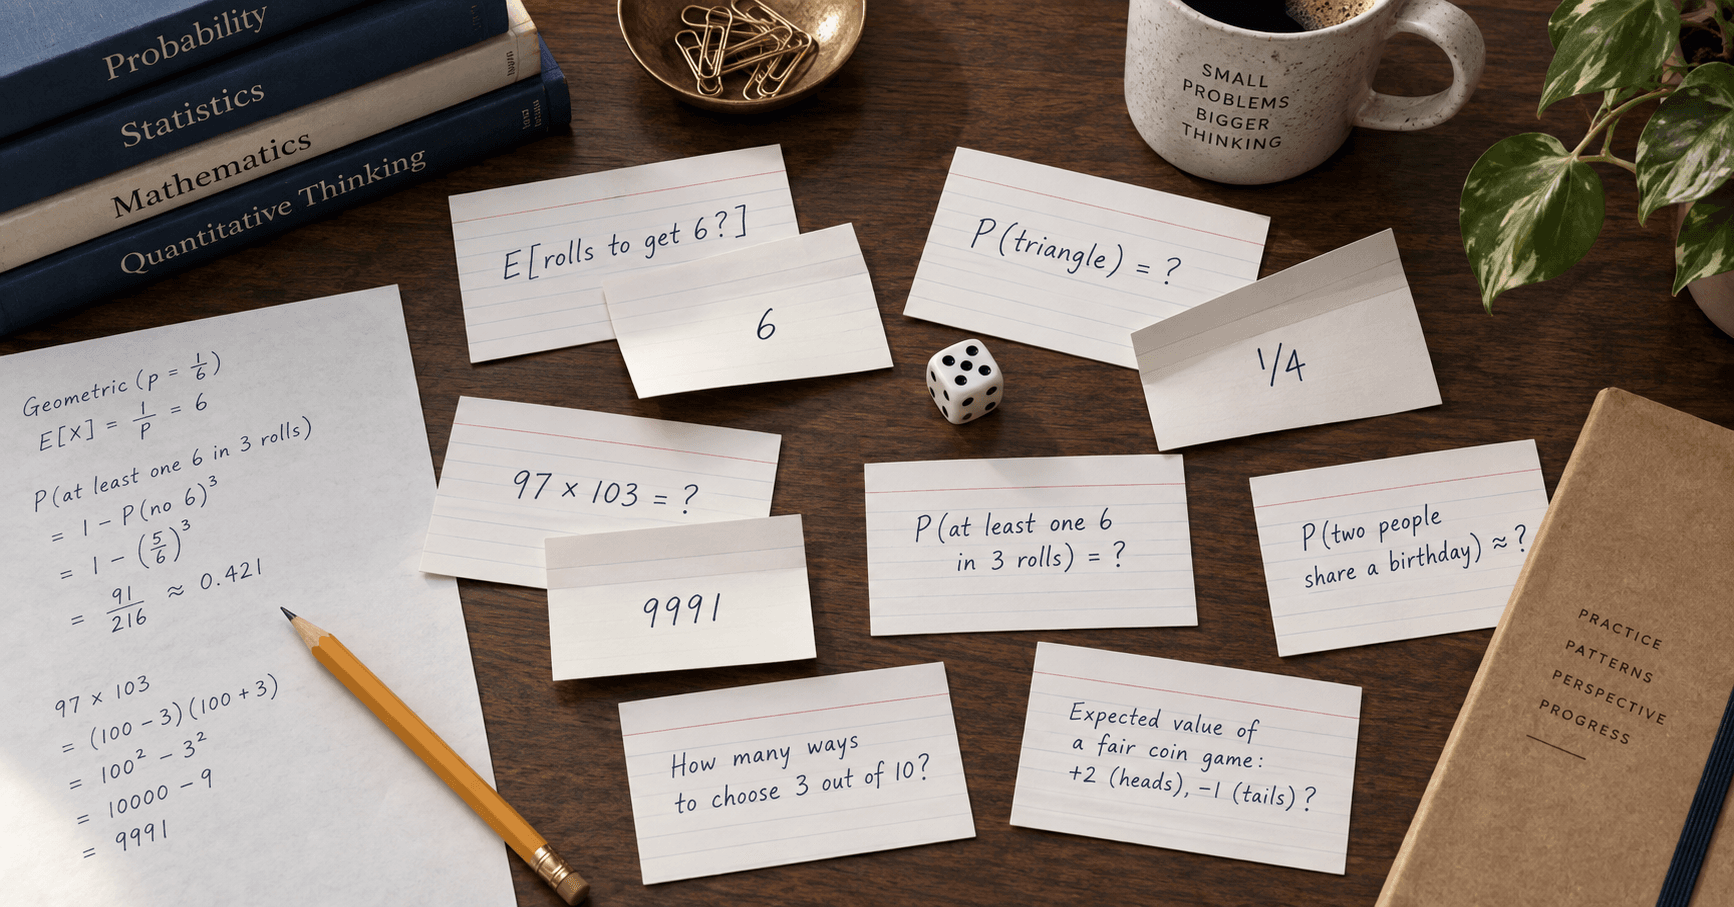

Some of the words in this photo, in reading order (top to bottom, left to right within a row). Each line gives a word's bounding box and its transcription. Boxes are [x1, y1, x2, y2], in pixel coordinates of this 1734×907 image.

[102, 6, 269, 81] Probability
[1182, 79, 1290, 109] PROBLEMS
[1202, 63, 1269, 88] SMALL
[121, 83, 266, 148] Statistics
[1182, 122, 1282, 150] THINKING
[1196, 108, 1269, 131] BIGGER
[110, 132, 312, 219] Mathematics
[120, 201, 293, 276] Quantitative
[298, 150, 427, 211] Thinking
[503, 237, 594, 281] E[rolls
[607, 233, 631, 257] to
[644, 222, 681, 260] get
[970, 217, 1124, 279] P(triangle)
[756, 307, 776, 341] 6
[1256, 342, 1307, 388] 1/4
[22, 379, 128, 417] Geometric
[195, 366, 206, 381] 6
[195, 392, 208, 412] 6
[34, 483, 83, 513] P(at
[93, 467, 140, 495] least
[150, 460, 182, 478] one
[192, 448, 203, 467] 6
[213, 445, 230, 461] in
[240, 435, 252, 453] 3
[261, 415, 312, 447] rolls)
[513, 469, 553, 500] 97
[591, 480, 638, 507] 103
[122, 498, 172, 526] P(no
[915, 512, 972, 545] P(at
[985, 511, 1037, 537] least
[1049, 517, 1086, 532] one
[1099, 507, 1113, 531] 6
[1301, 519, 1366, 552] P(two
[1378, 503, 1442, 544] people
[155, 549, 166, 565] 6
[200, 557, 262, 590] 0.421
[957, 552, 976, 572] in
[991, 549, 1004, 571] 3
[1017, 542, 1074, 573] rolls)
[1304, 564, 1357, 589] share
[1367, 563, 1380, 576] a
[1389, 532, 1482, 572] birthday)
[111, 585, 132, 605] 91
[643, 592, 721, 629] 9991
[110, 611, 148, 634] 216
[1578, 609, 1663, 650] PRACTICE
[1565, 640, 1654, 684] PATTERNS
[54, 695, 80, 718] 97
[116, 674, 150, 700] 103
[1552, 669, 1667, 726] PERSPECTIVE
[90, 721, 133, 751] (100
[1069, 701, 1162, 730] Expected
[1173, 713, 1223, 736] value
[1236, 718, 1261, 745] of
[1538, 699, 1631, 745] PROGRESS
[671, 751, 717, 779] How
[733, 746, 791, 770] many
[807, 735, 859, 761] ways
[1072, 738, 1084, 751] a
[1097, 732, 1137, 757] fair
[1148, 743, 1188, 762] coin
[1200, 752, 1264, 773] game:
[109, 784, 169, 819] 10000
[200, 768, 212, 789] 9
[674, 792, 697, 815] to
[711, 783, 781, 809] choose
[795, 774, 809, 797] 3
[821, 767, 854, 792] out
[864, 760, 885, 790] of
[896, 752, 930, 782] 10?
[1068, 765, 1096, 784] +2
[1109, 765, 1189, 799] (heads),
[1198, 781, 1221, 799] -1
[115, 819, 167, 852] 9991
